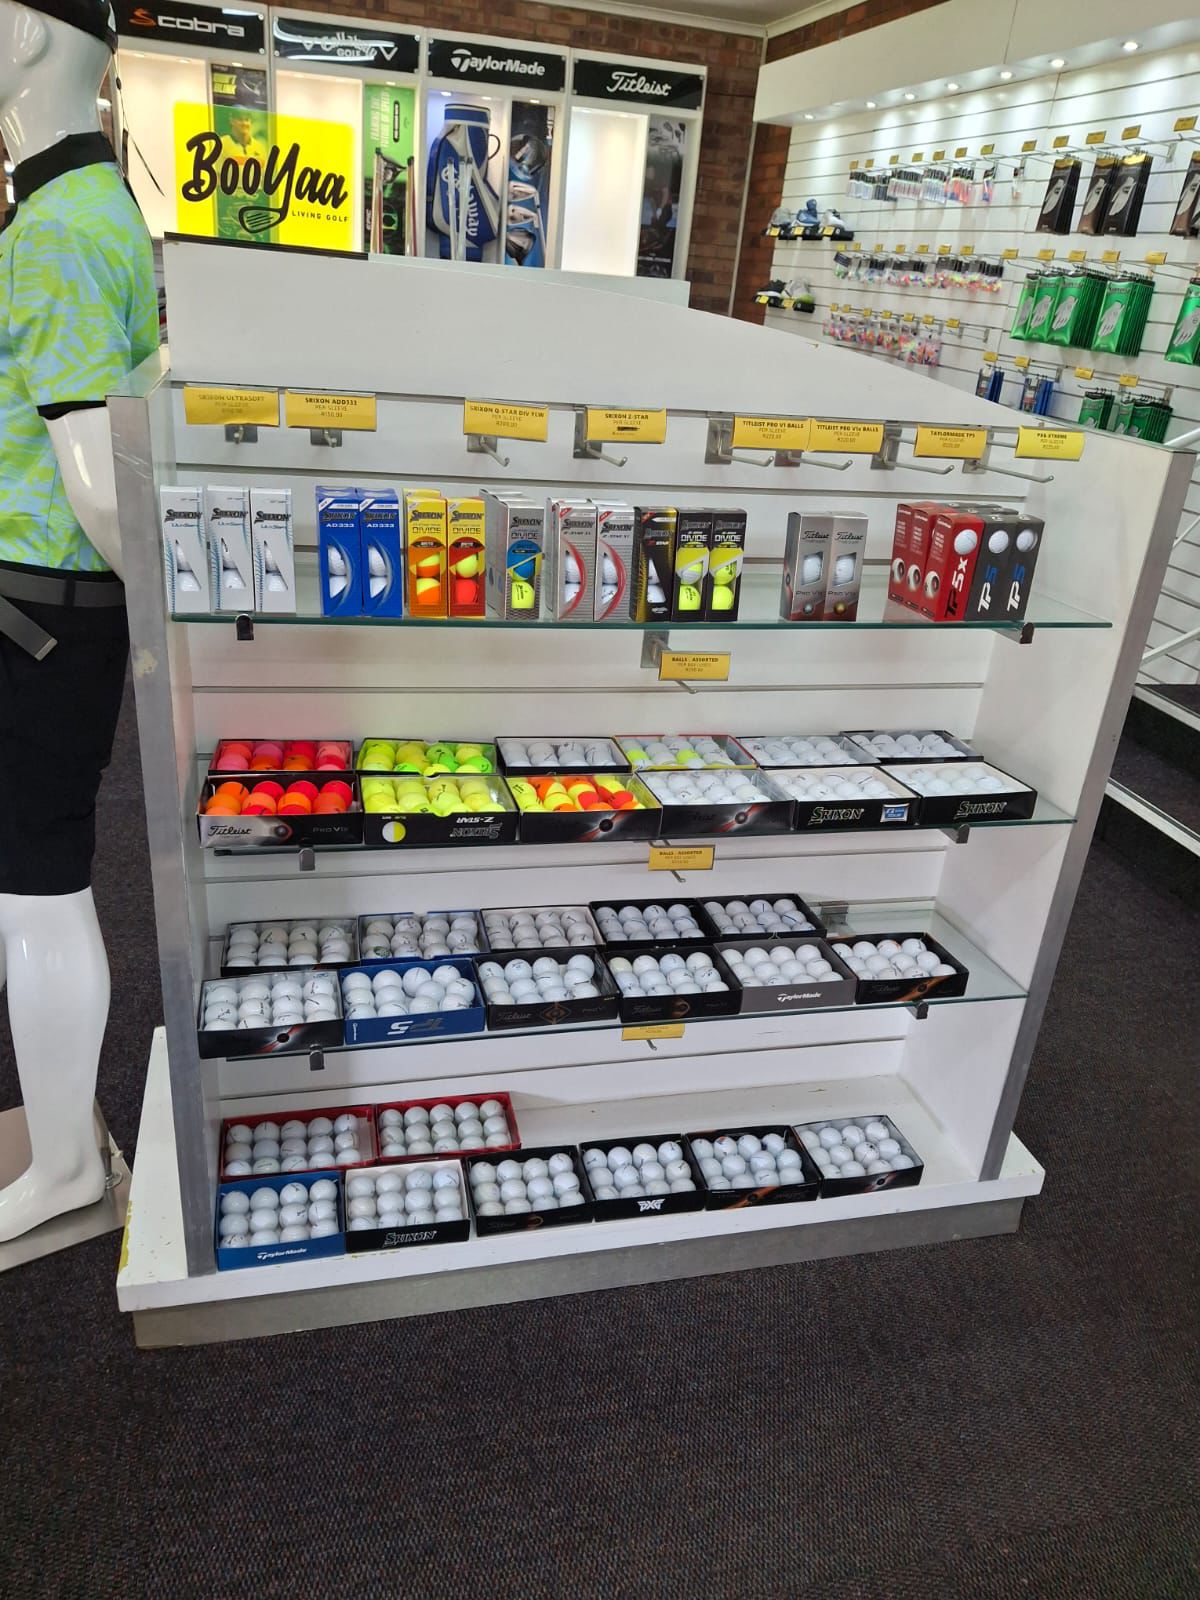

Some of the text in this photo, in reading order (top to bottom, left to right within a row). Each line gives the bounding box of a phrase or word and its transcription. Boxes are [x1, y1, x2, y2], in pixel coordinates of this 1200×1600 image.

[157, 14, 245, 38] cobra
[450, 48, 546, 76] TaylorMade
[606, 71, 672, 97] Titleist
[181, 131, 349, 210] BooYaa
[291, 210, 349, 223] LIVING GOLF
[164, 508, 202, 522] SRIXON
[211, 507, 249, 522] SRIXON
[254, 510, 292, 524] SRIXON
[409, 509, 444, 522] SRIXON
[450, 510, 484, 523] SRIXON
[510, 515, 544, 529] SRIXON
[561, 518, 595, 531] SRIXON
[600, 521, 634, 534] SRIXON
[412, 526, 441, 534] DIVIDE
[452, 527, 481, 535] DIVIDE
[802, 530, 830, 541] Titleist
[834, 531, 864, 541] Titleist
[681, 534, 708, 542] DIVIDE
[715, 534, 742, 542] DIVIDE
[808, 806, 865, 826] SRIXON
[953, 800, 1008, 820] SRIXON
[207, 824, 253, 837] Titleist
[776, 991, 822, 1003] TaylorMade
[637, 1198, 666, 1213] PXG
[382, 1230, 438, 1248] SRIXON
[256, 1247, 308, 1260] TaylorMade
